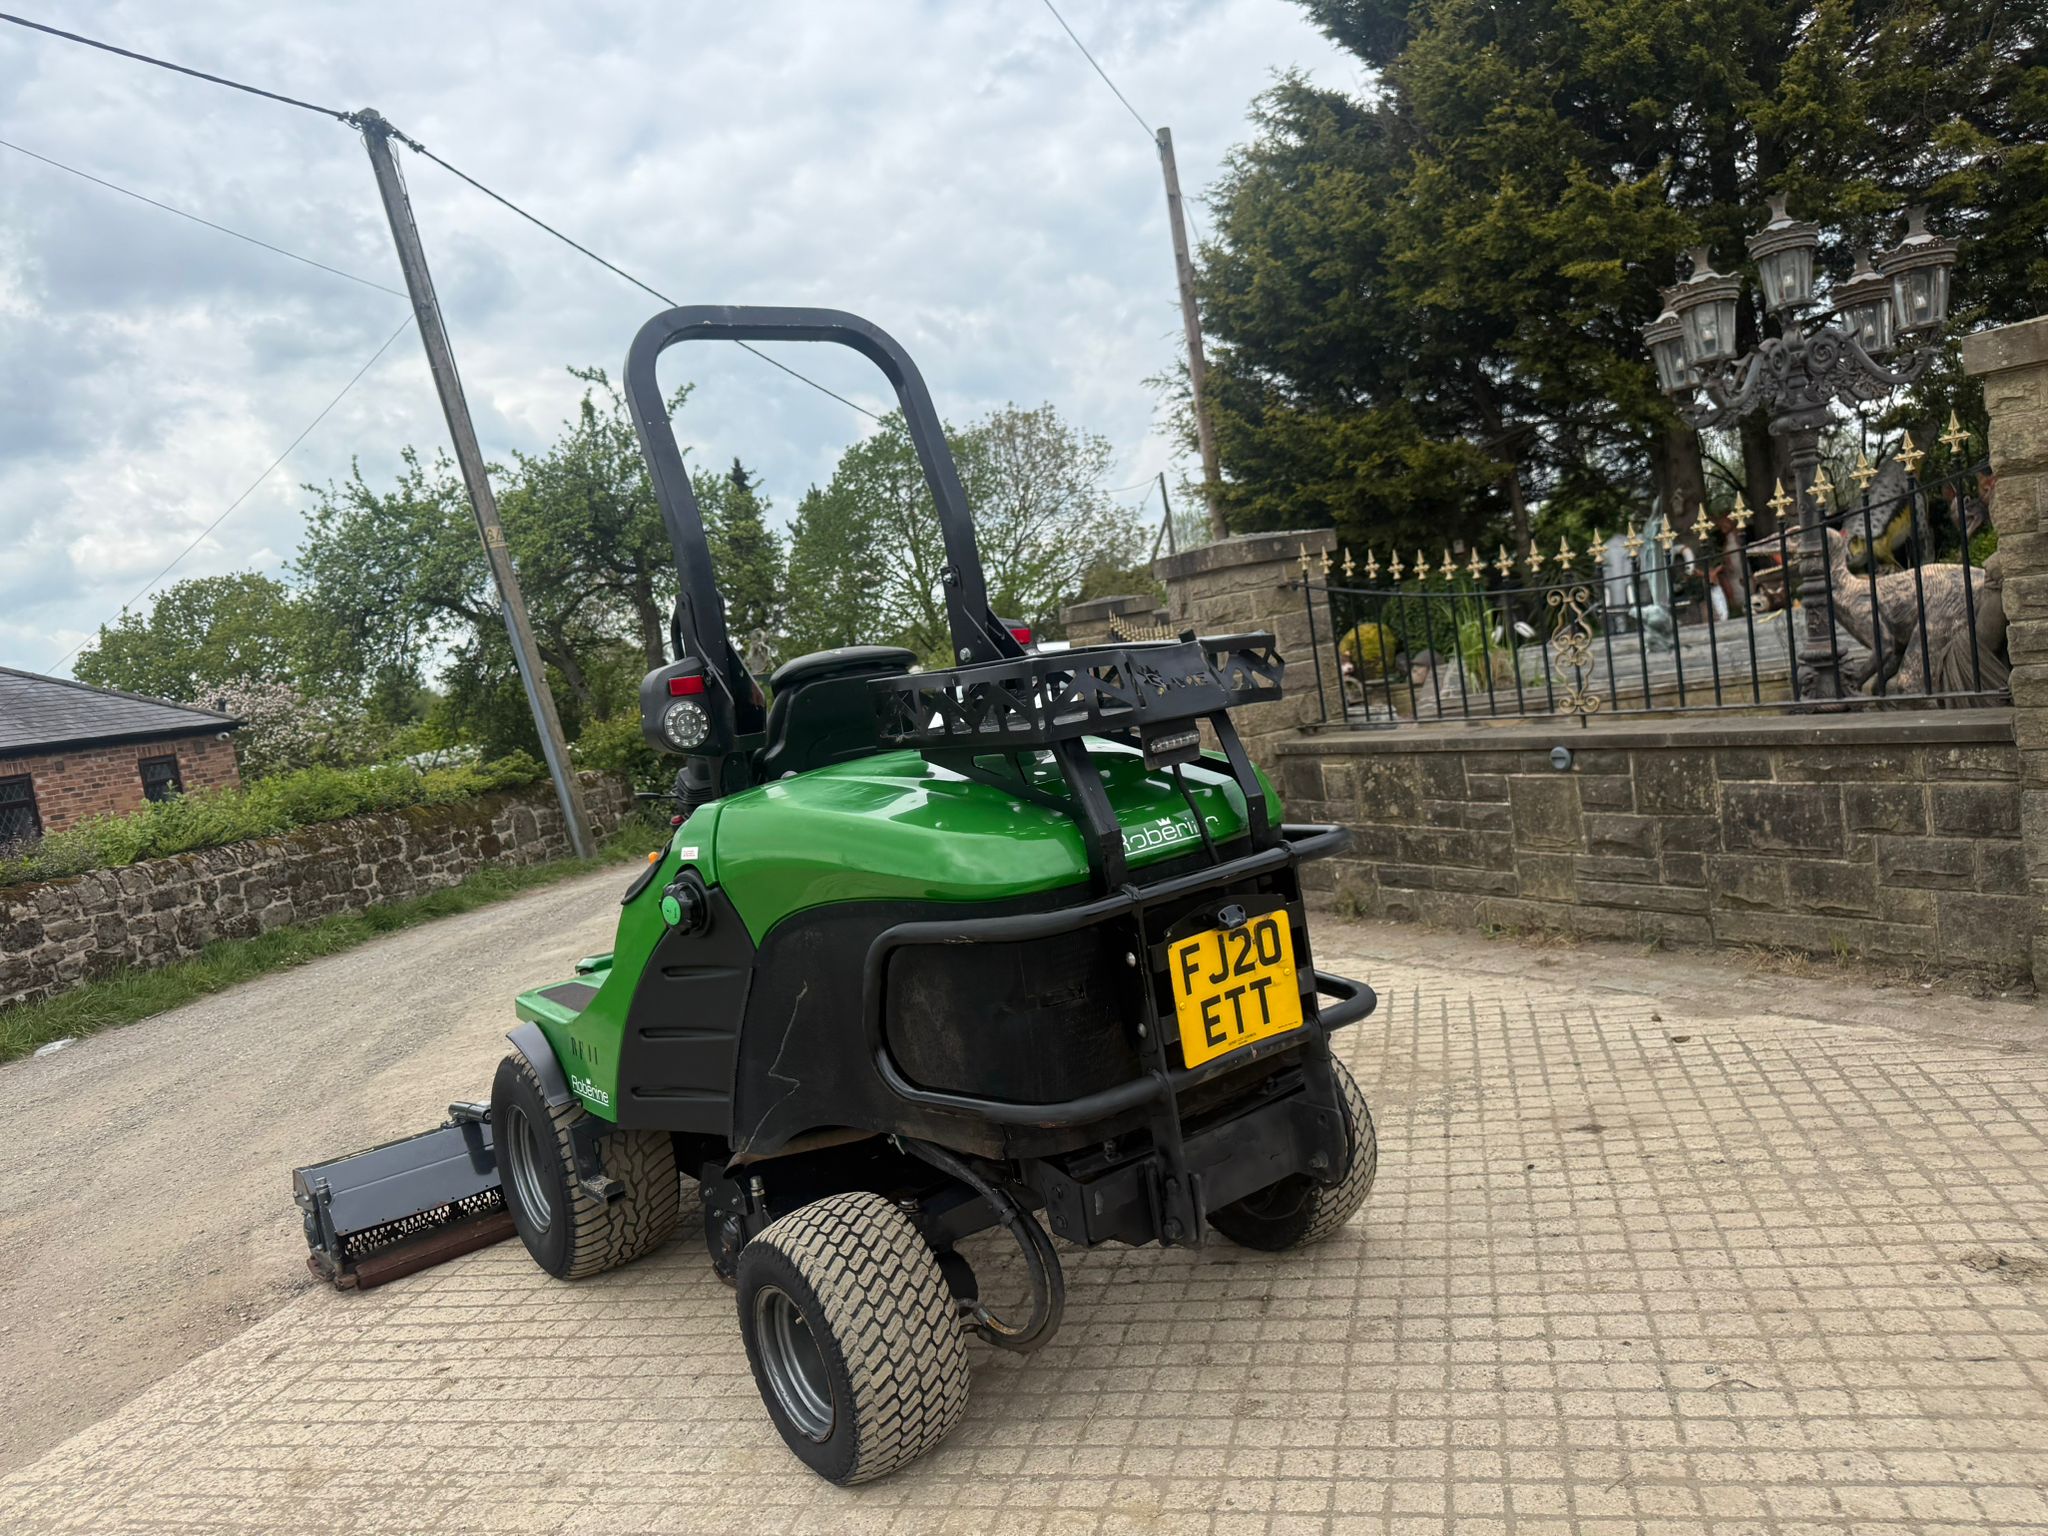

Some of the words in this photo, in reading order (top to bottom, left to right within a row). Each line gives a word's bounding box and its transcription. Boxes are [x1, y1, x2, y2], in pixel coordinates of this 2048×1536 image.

[1121, 815, 1220, 852] Roberi
[1179, 918, 1283, 997] FJ20
[1200, 976, 1273, 1048] ETT
[571, 1074, 609, 1104] Roberine
